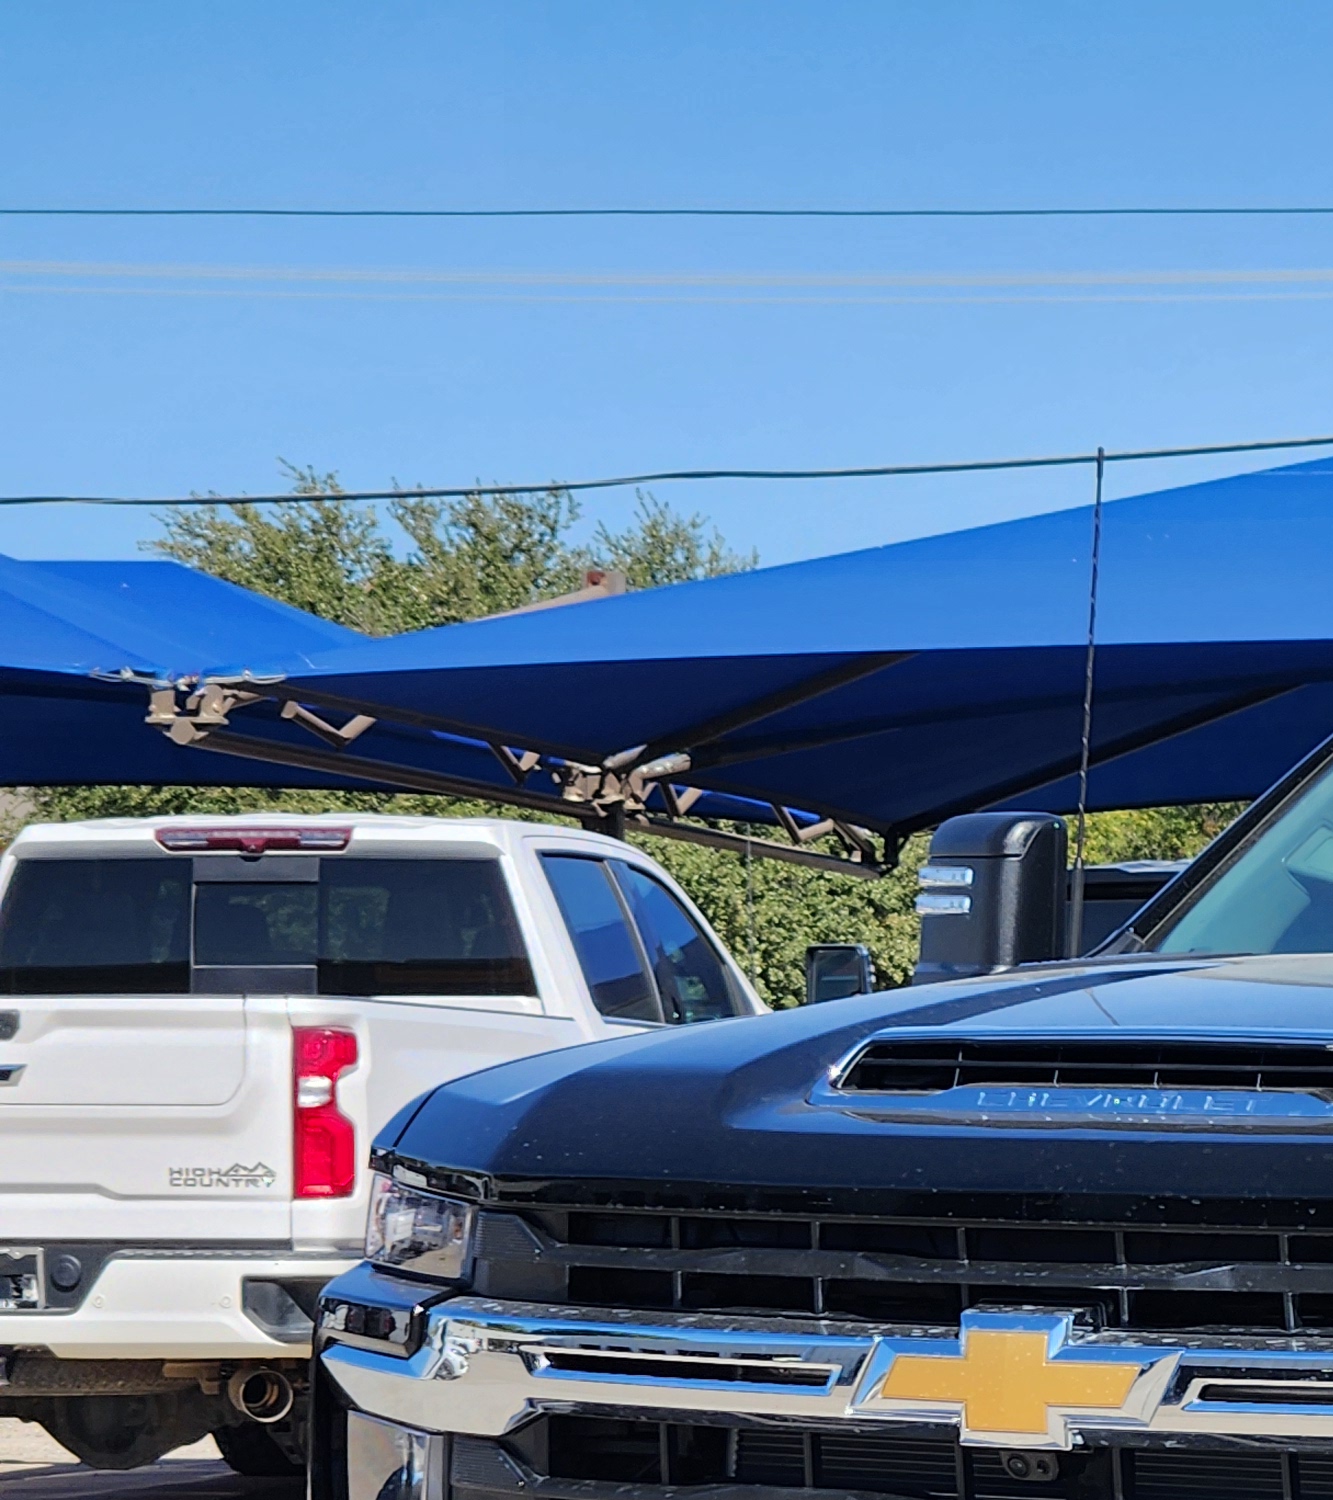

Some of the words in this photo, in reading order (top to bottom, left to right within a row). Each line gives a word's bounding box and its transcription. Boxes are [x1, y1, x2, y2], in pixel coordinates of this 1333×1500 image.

[976, 1090, 1273, 1112] CHEVROLET
[168, 1167, 221, 1177] HIGH
[168, 1177, 275, 1188] COUNTRY
